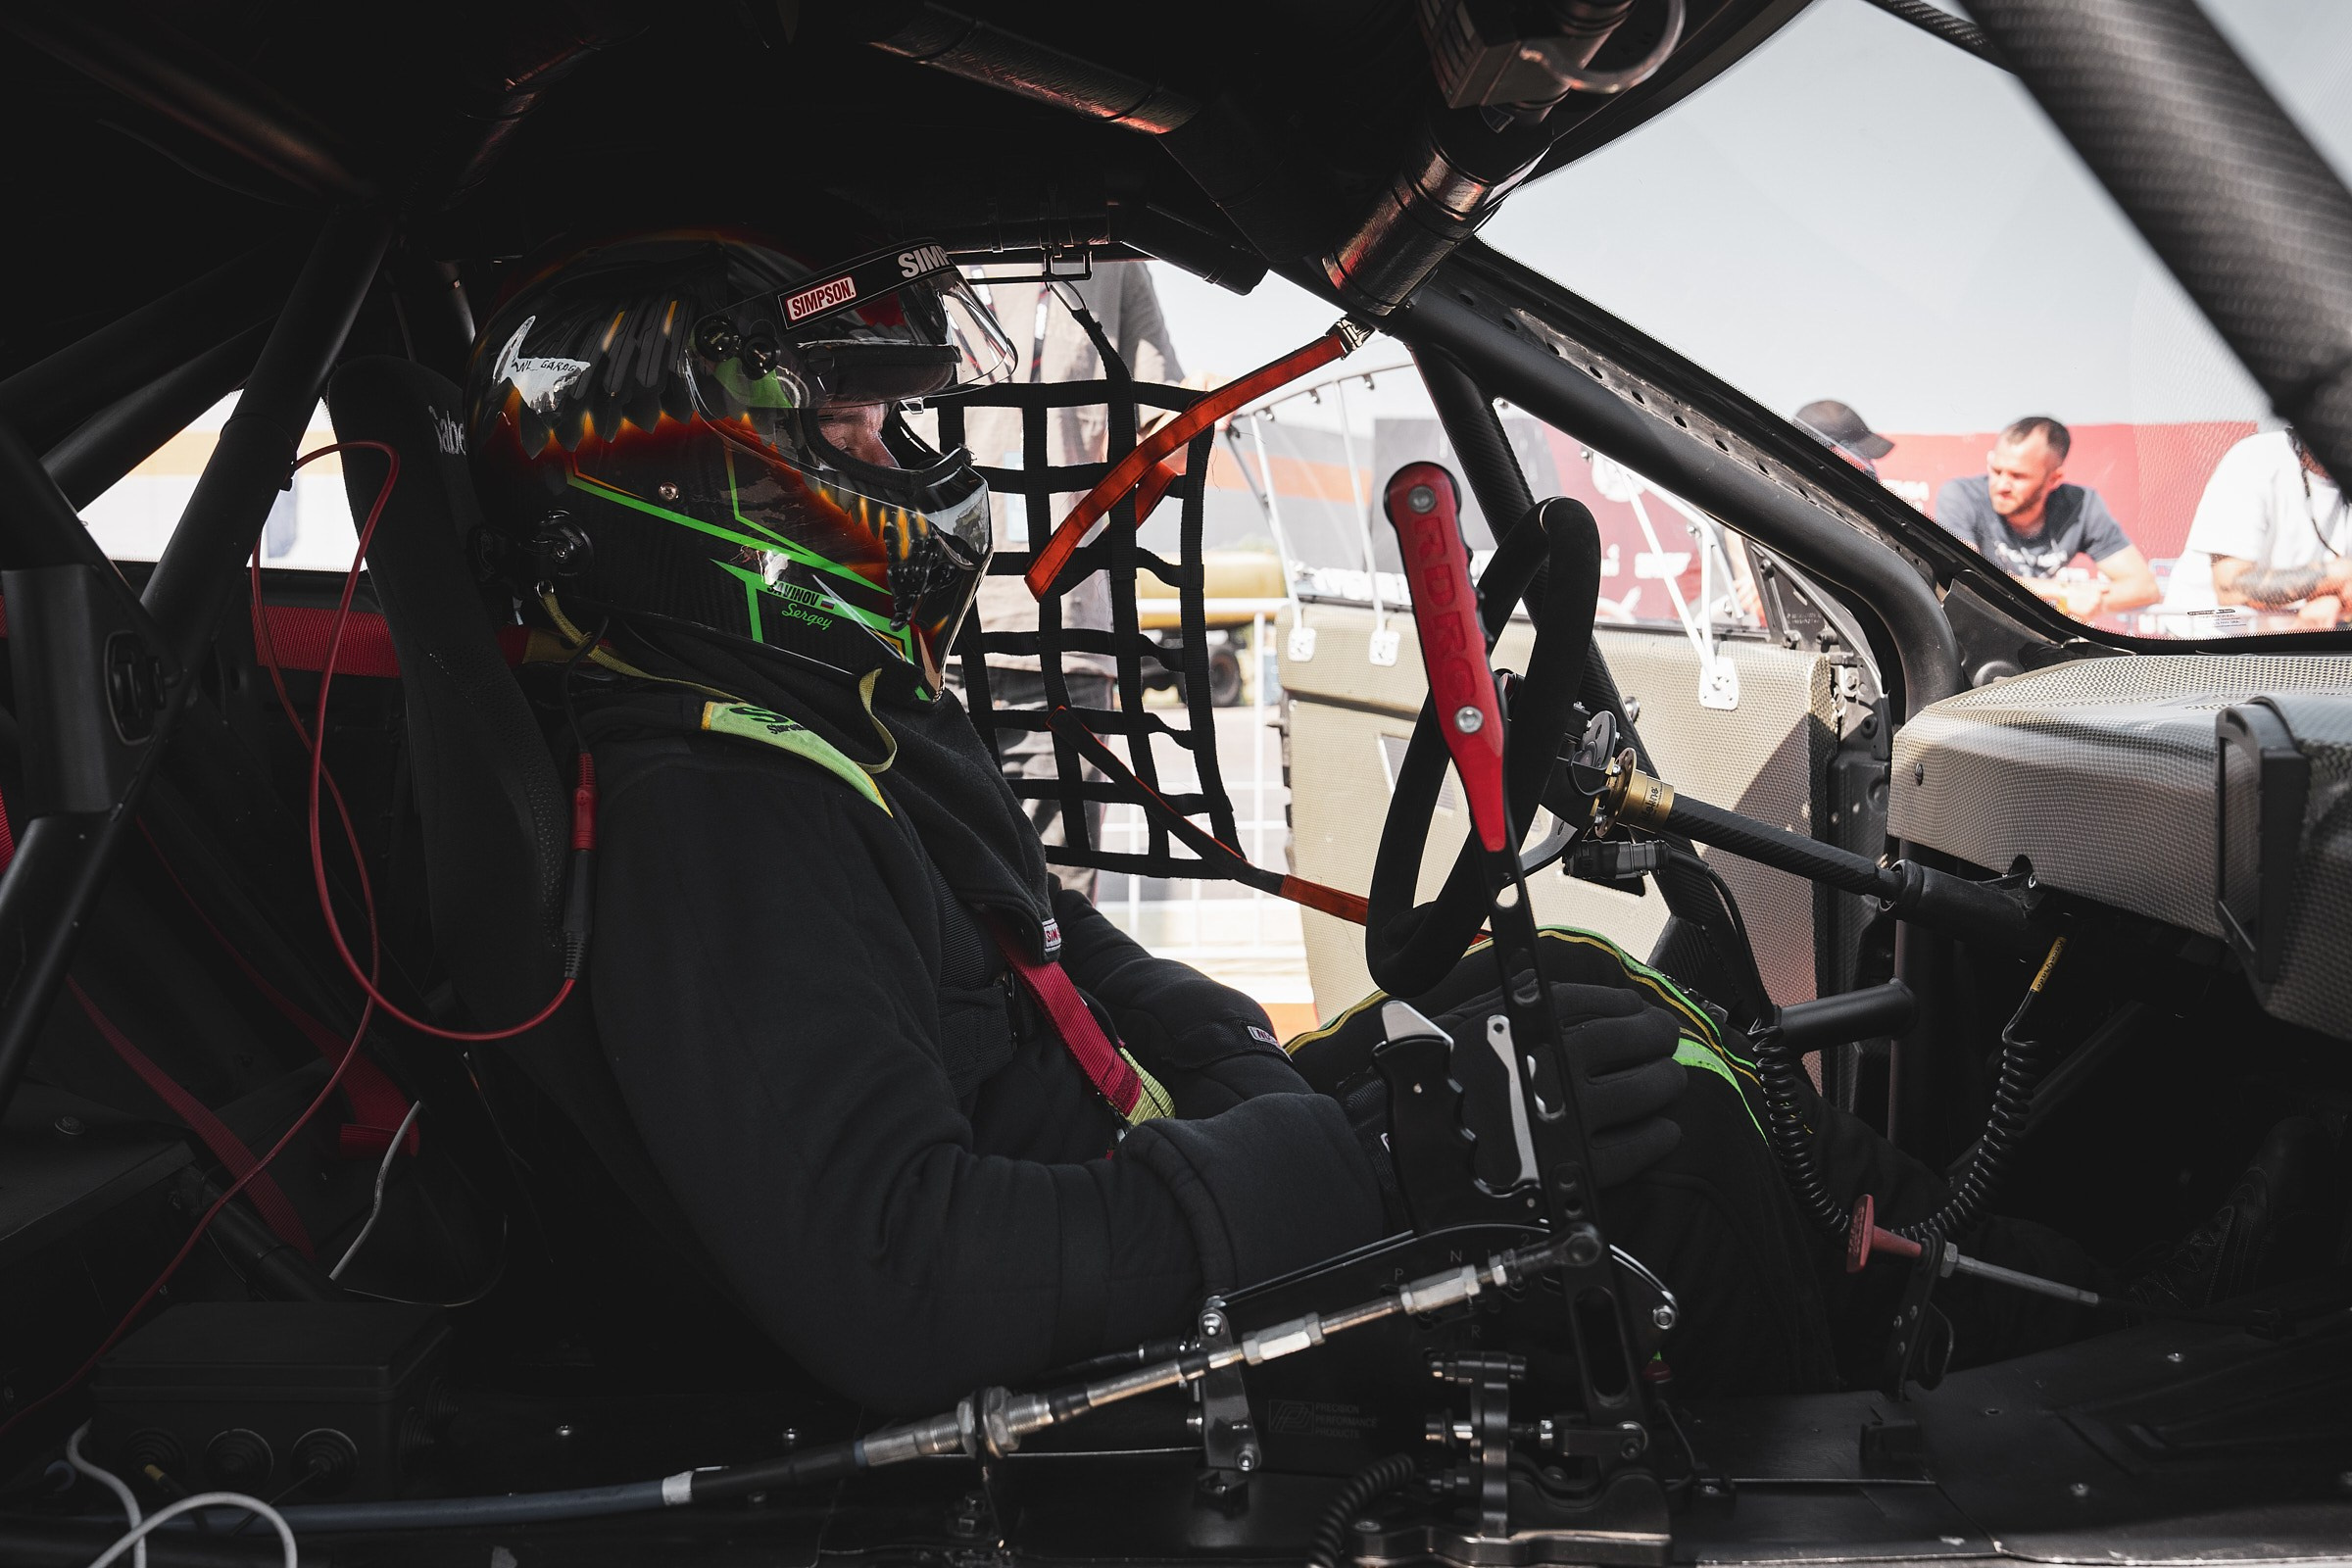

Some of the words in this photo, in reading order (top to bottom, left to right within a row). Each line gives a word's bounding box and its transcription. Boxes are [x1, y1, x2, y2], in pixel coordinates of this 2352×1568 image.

[781, 603, 833, 631] Sergey
[1395, 1268, 1404, 1281] P
[1450, 1250, 1462, 1263] N
[1472, 1325, 1482, 1339] R
[1315, 1402, 1360, 1414] PRECISION
[1315, 1414, 1378, 1428] PERFORMANCE
[1315, 1427, 1360, 1439] PRODUCTS
